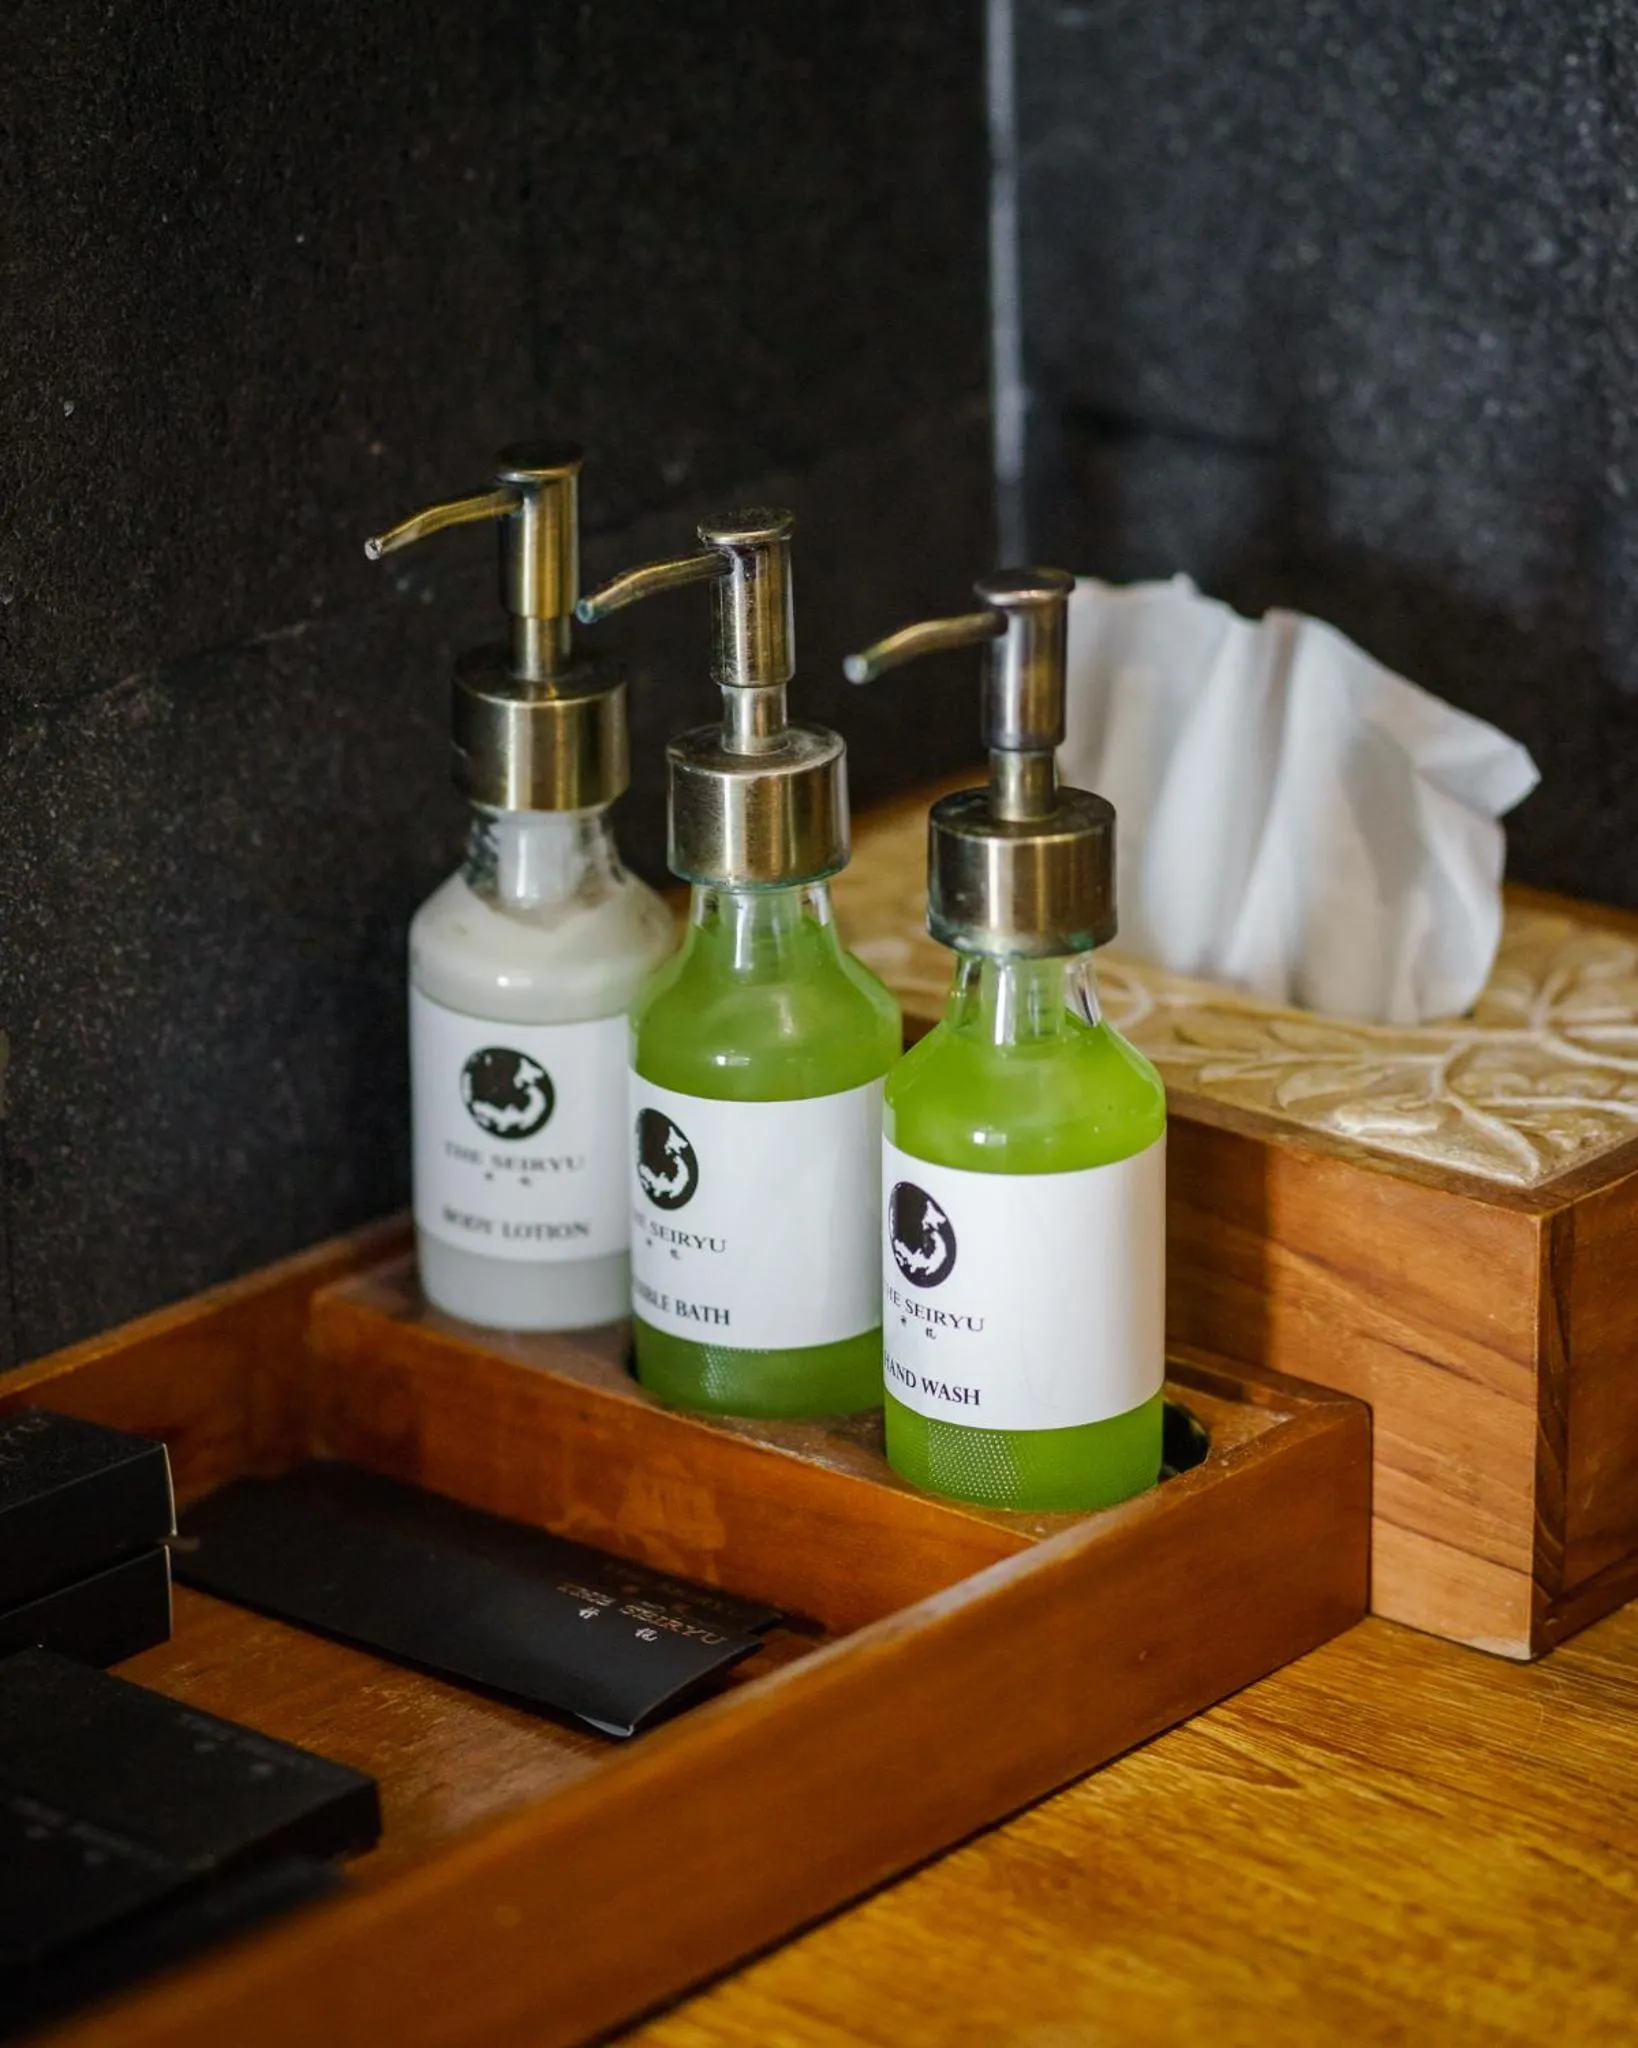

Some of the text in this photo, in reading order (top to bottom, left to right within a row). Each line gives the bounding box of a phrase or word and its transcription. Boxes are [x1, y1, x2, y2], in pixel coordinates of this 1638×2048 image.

[491, 1154, 585, 1173] SEIRYU
[501, 1221, 591, 1241] LOTION
[650, 1221, 727, 1254] SEIRYU
[675, 1298, 731, 1326] BATH
[885, 1283, 901, 1307] HE
[905, 1298, 985, 1333] SEIRYU
[921, 1377, 981, 1406] WASH
